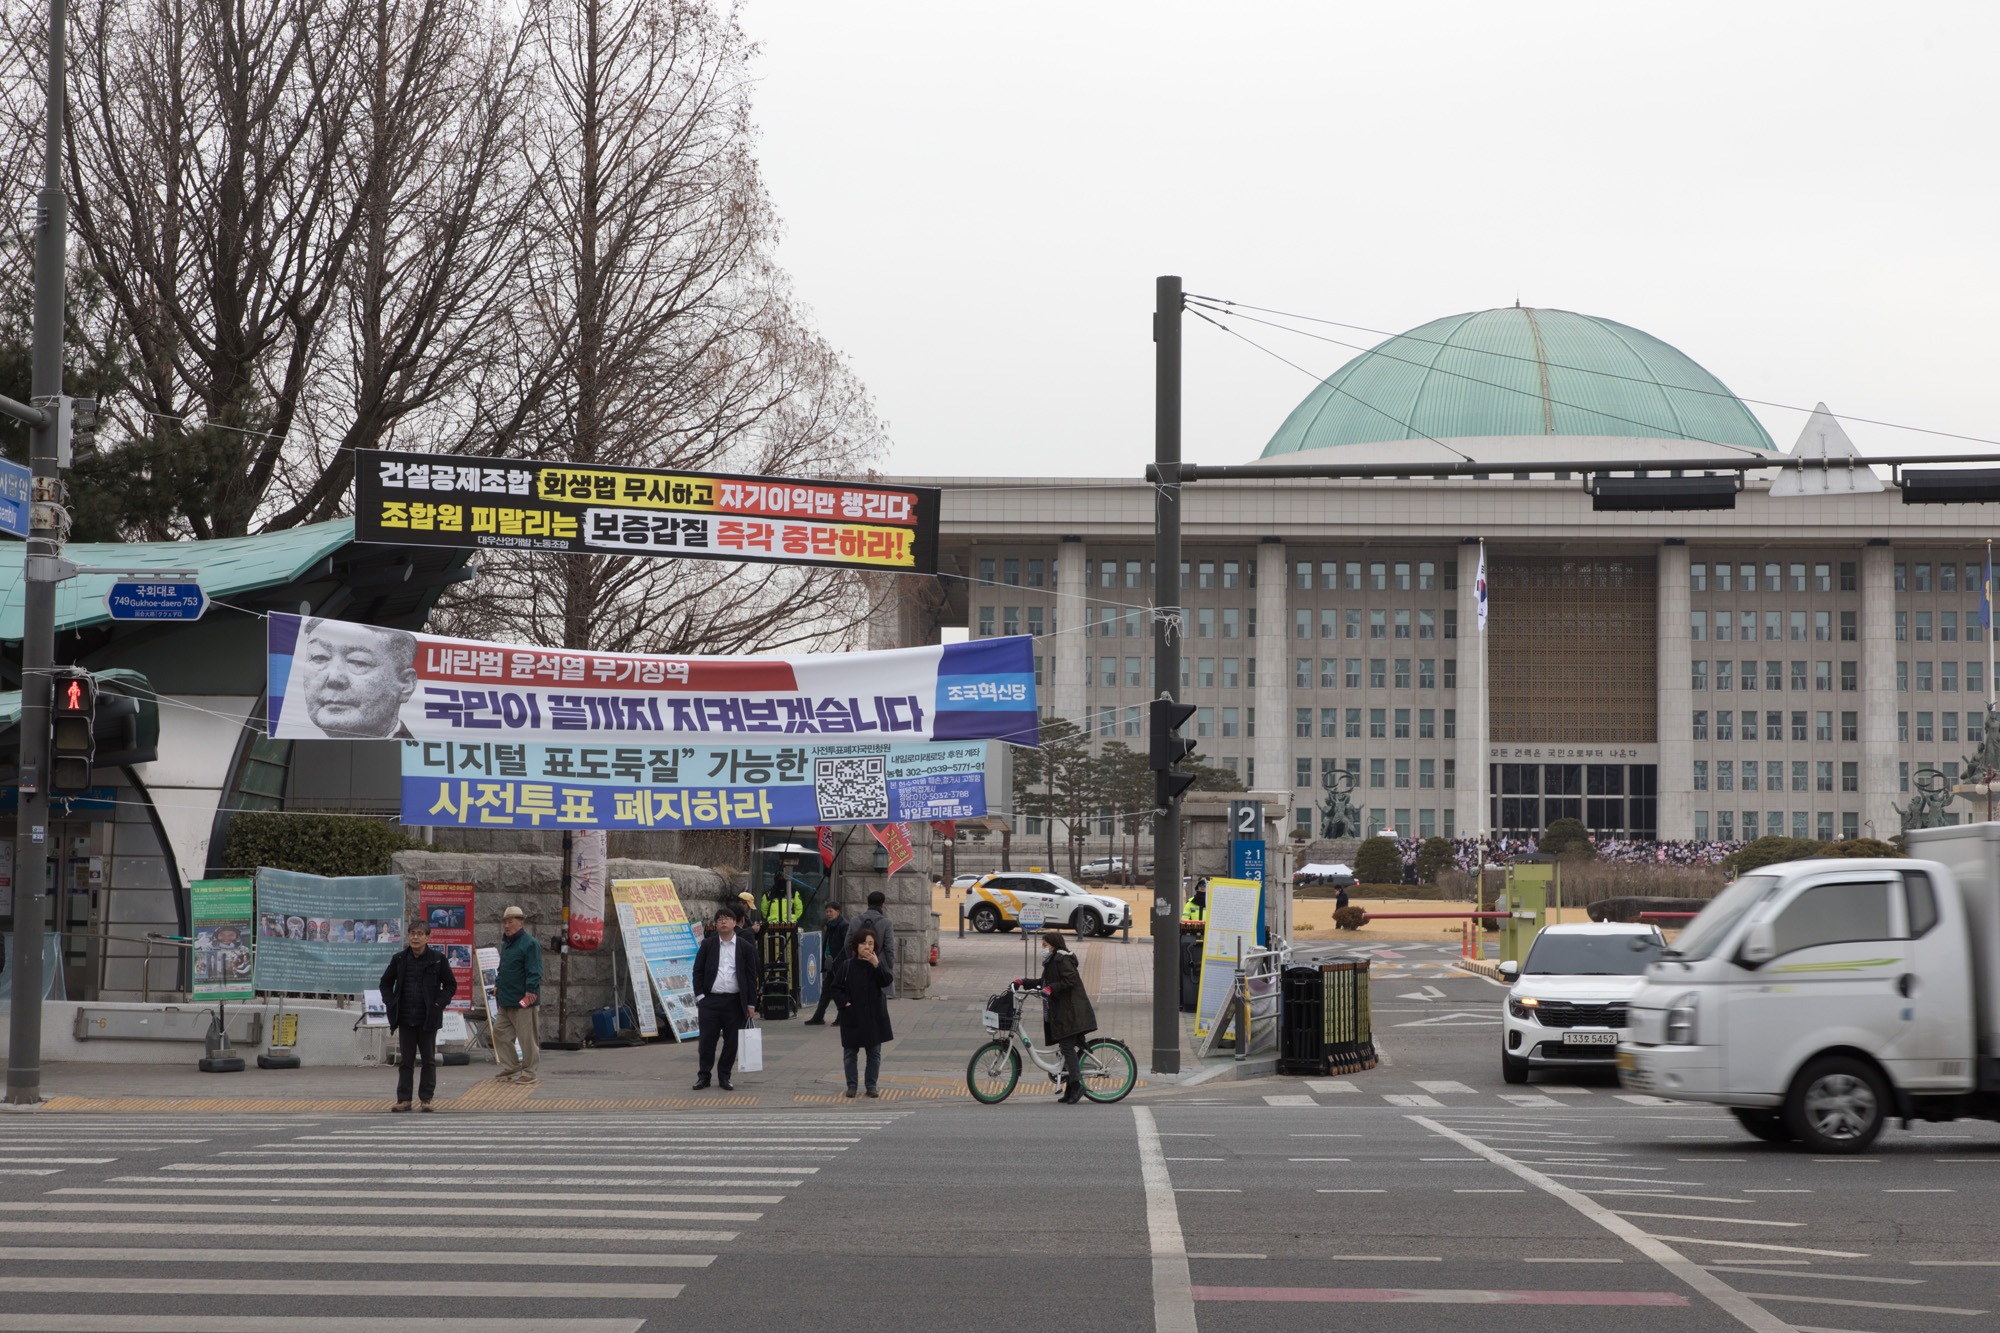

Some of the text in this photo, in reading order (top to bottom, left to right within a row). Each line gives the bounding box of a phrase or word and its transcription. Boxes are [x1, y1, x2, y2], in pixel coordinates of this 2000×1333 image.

[379, 461, 912, 520] 건설공제조합 회생법 무시하고 자기이익만 챙긴다
[380, 501, 904, 560] 조합원 피말리는 보증갑질 즉각 중단하라!
[477, 535, 570, 550] 대우산업개발 노동조합
[135, 585, 178, 598] 국회대로
[114, 597, 198, 608] 749 Gukhoe-daero 753
[427, 648, 690, 684] 내란범 윤석열 무기징역
[947, 682, 1026, 702] 조국혁신당
[423, 687, 925, 734] 국민이 끝까지 지켜보겠습니다
[811, 743, 891, 756] 사전투표폐지국민청원
[891, 747, 980, 764] 내일로미래로당 후원 계좌
[1490, 749, 1638, 758] 모든 권력은 국민으로부터 나온다
[707, 748, 808, 784] 가능한
[428, 781, 773, 826] 사전투표 폐지하라
[899, 805, 973, 820] 내일로미래로당
[1238, 807, 1255, 833] 2
[1256, 849, 1261, 860] 1
[1253, 870, 1262, 881] 3
[1591, 1035, 1614, 1043] 5452
